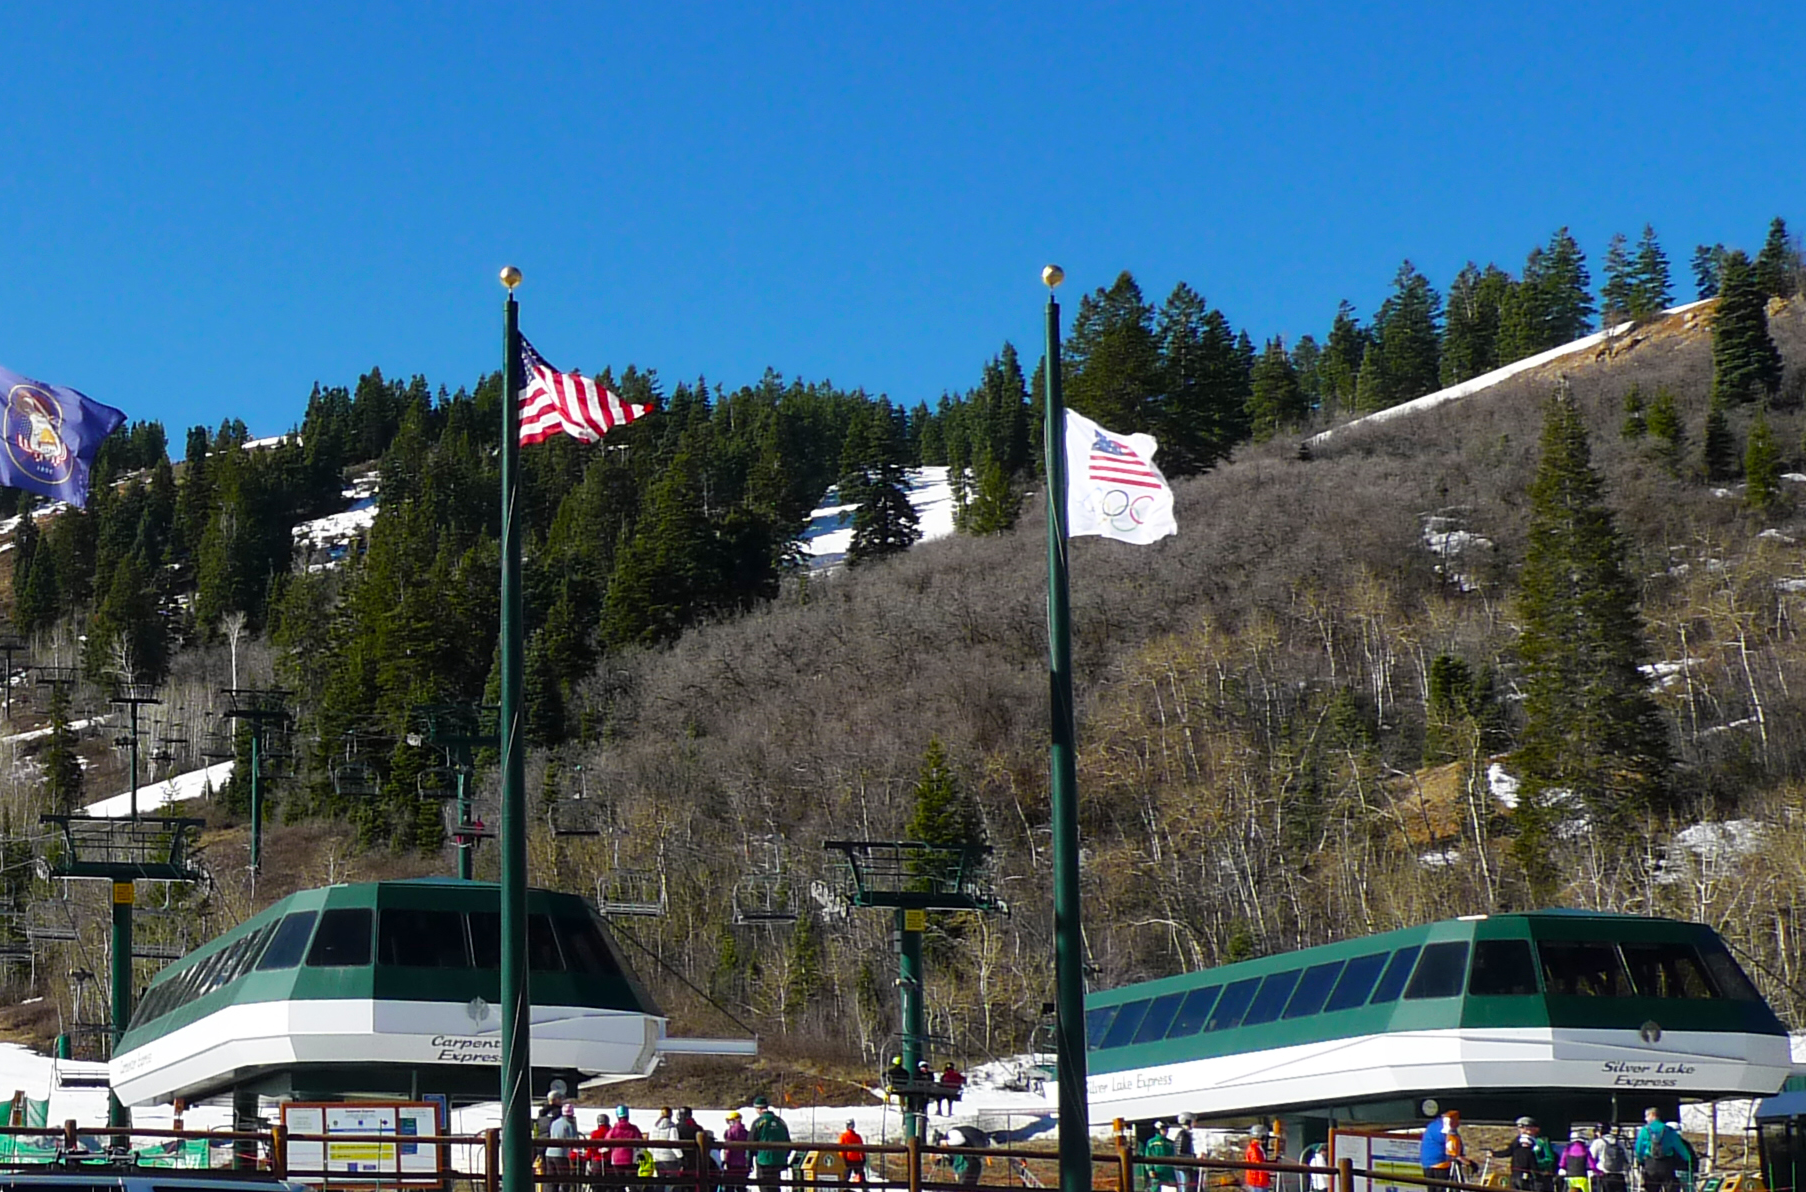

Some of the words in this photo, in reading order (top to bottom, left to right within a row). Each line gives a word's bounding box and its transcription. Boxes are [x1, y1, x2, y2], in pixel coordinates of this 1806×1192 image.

[431, 1035, 501, 1050] Carpent
[1601, 1061, 1650, 1073] Silver
[1655, 1062, 1696, 1074] Lake
[1087, 1080, 1108, 1095] ilver
[1112, 1076, 1133, 1092] Lake
[1136, 1074, 1173, 1092] Express
[1614, 1074, 1677, 1087] Express
